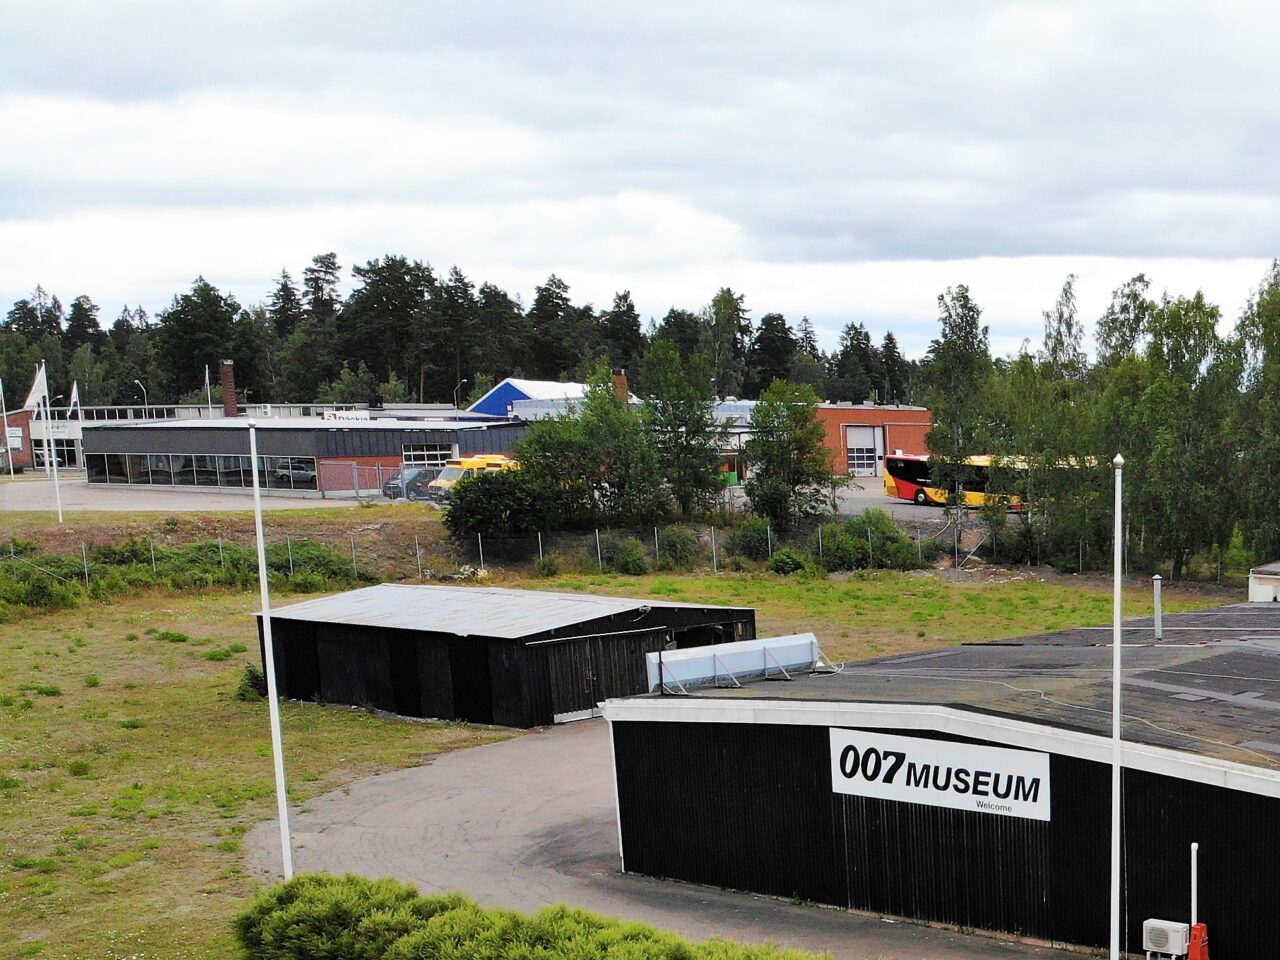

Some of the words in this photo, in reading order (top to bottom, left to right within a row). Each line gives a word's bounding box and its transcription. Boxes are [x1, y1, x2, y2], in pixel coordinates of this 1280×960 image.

[839, 744, 906, 784] 007
[905, 762, 1041, 803] MUSEUM
[975, 800, 1013, 813] Welcome
